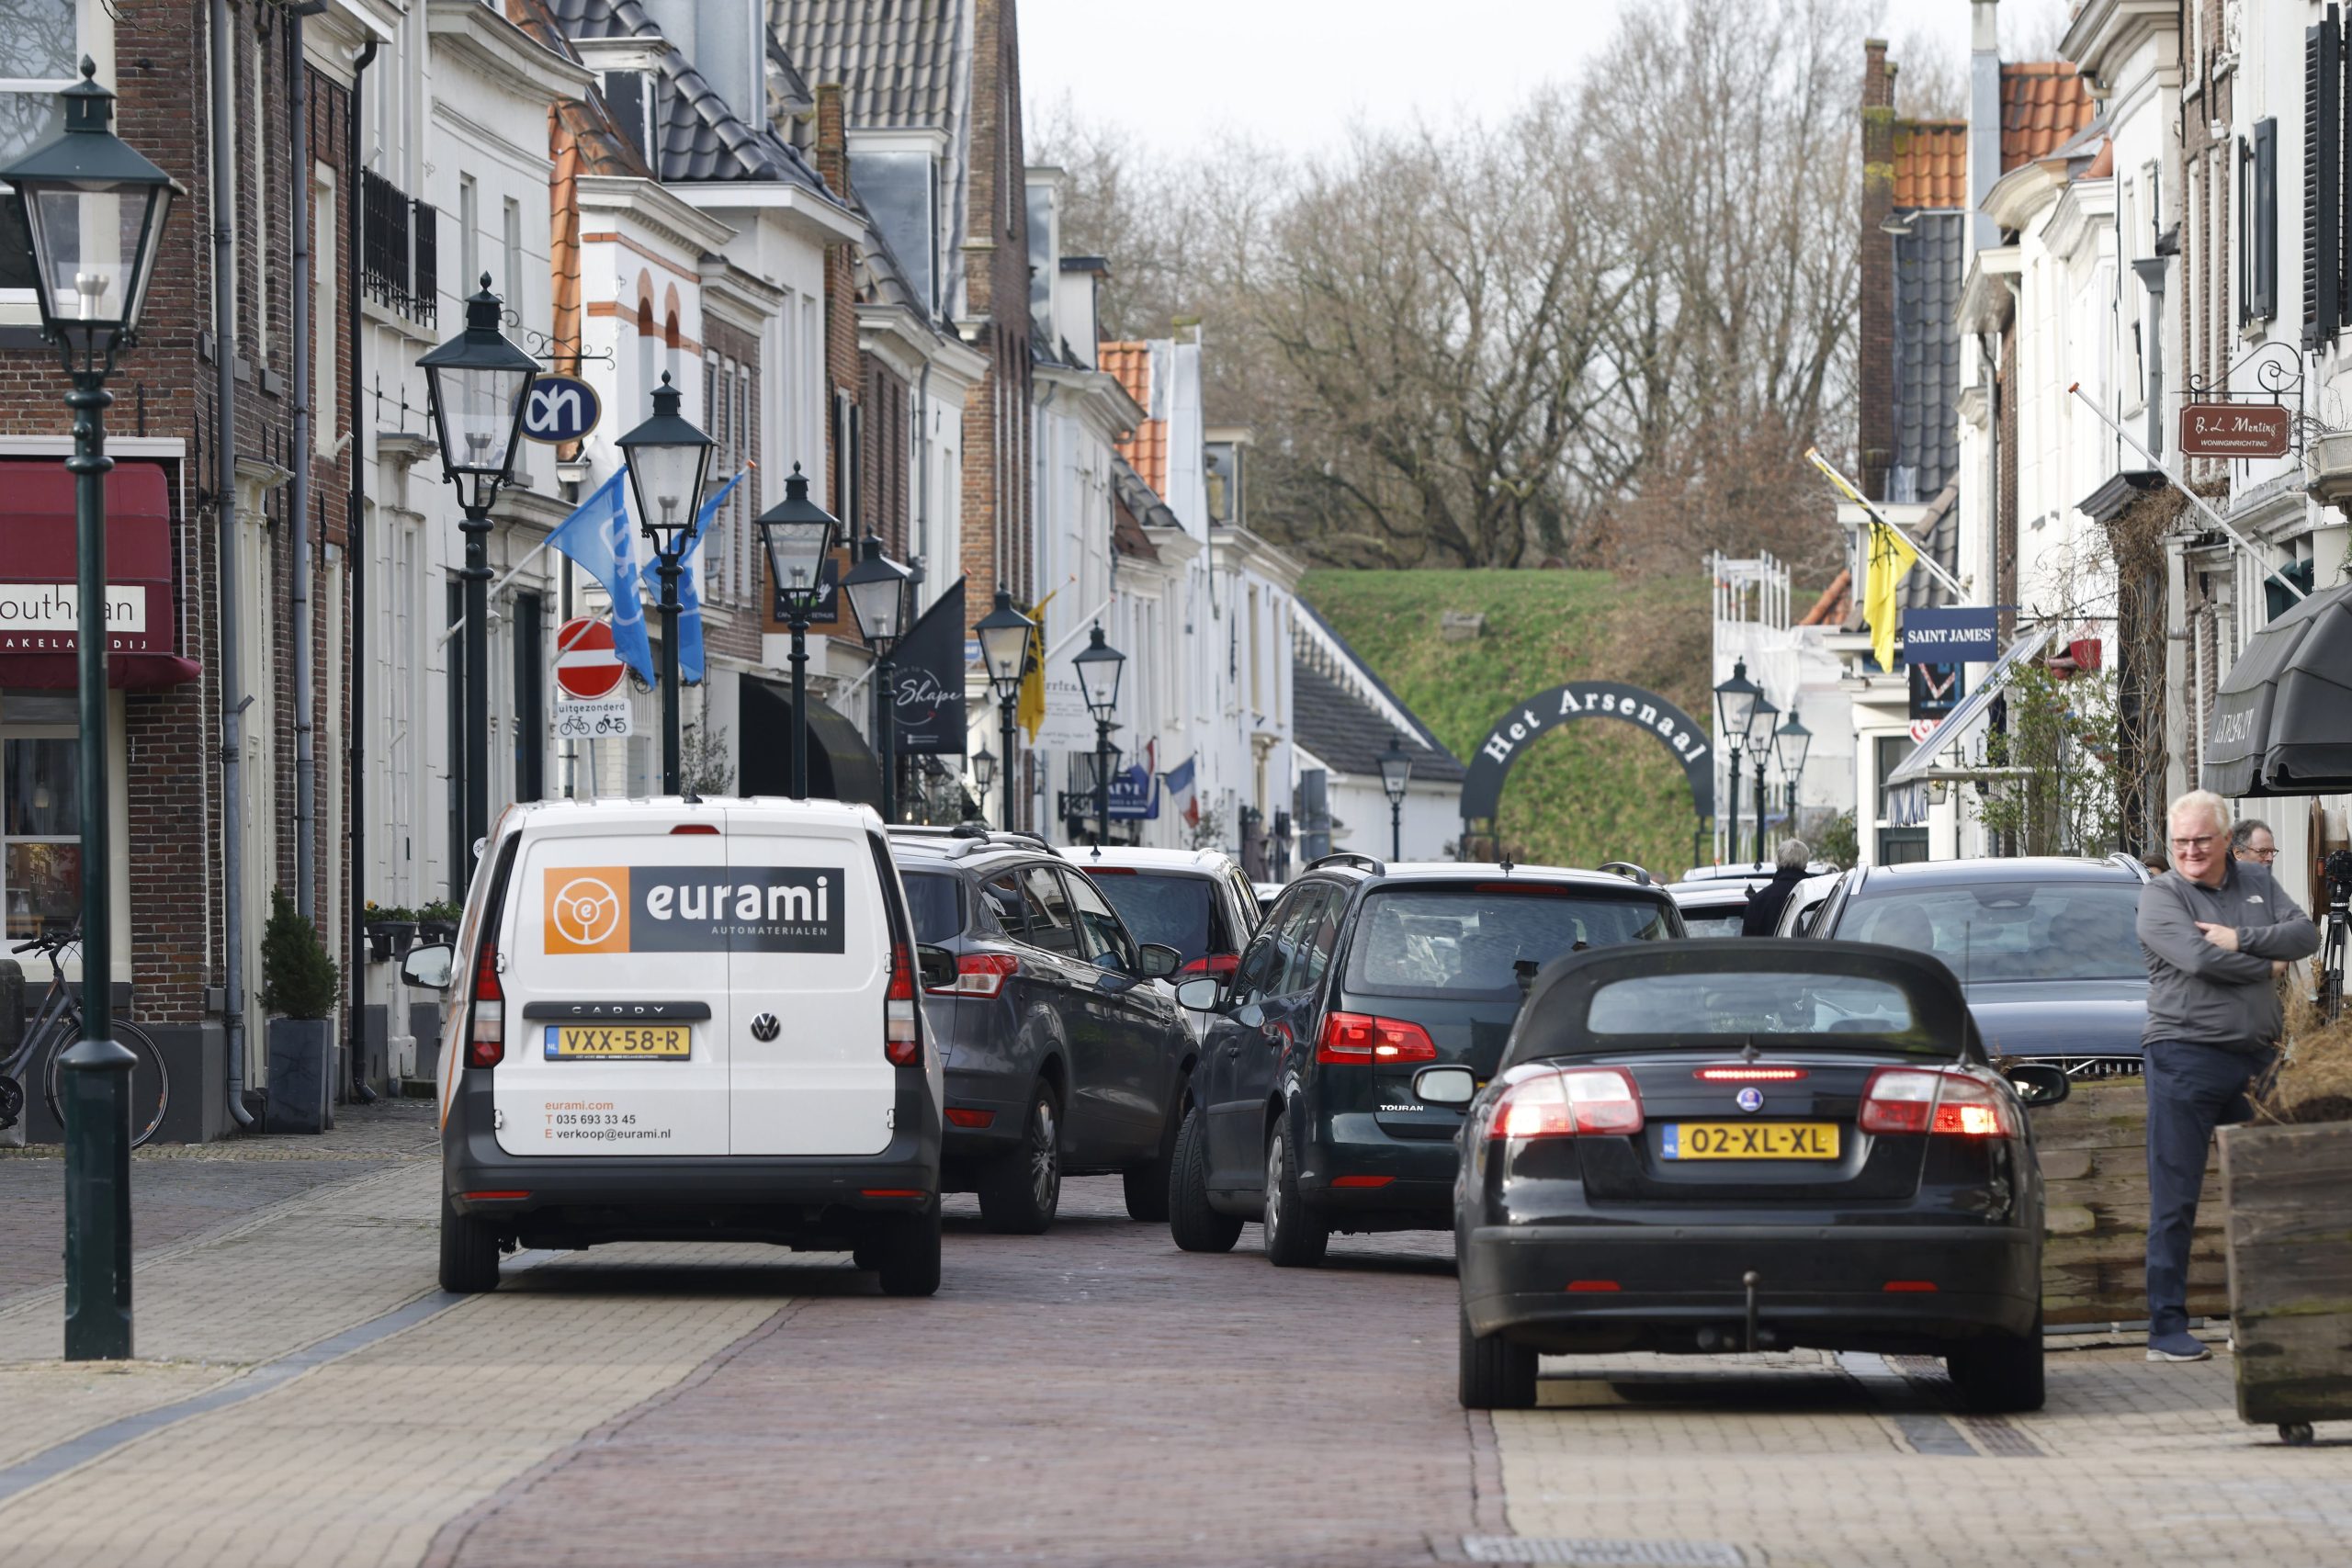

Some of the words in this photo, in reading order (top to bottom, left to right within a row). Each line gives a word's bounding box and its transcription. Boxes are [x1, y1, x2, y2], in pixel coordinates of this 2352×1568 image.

[2195, 416, 2208, 434] B.
[2200, 439, 2268, 447] WONINGINRICHTING
[1907, 629, 1947, 643] SAINT
[897, 679, 963, 709] Shape
[559, 703, 626, 714] uitgezonderd
[1483, 709, 1542, 764] Het
[1559, 689, 1707, 764] Arsenaal
[646, 875, 828, 921] eurami
[711, 926, 828, 936] AUTOMATERIALEN
[571, 1006, 664, 1014] CADDY
[566, 1030, 680, 1051] VXX-58-R
[545, 1100, 614, 1111] eurami.com
[546, 1115, 552, 1124] T
[556, 1114, 577, 1125] 035
[581, 1114, 601, 1125] 693
[605, 1114, 618, 1125] 33
[622, 1114, 636, 1125] 45
[546, 1129, 552, 1139] E
[557, 1129, 672, 1142] verkoop@eurami.nl
[1664, 1144, 1677, 1155] NL
[1691, 1128, 1828, 1153] 02-XL-XL
